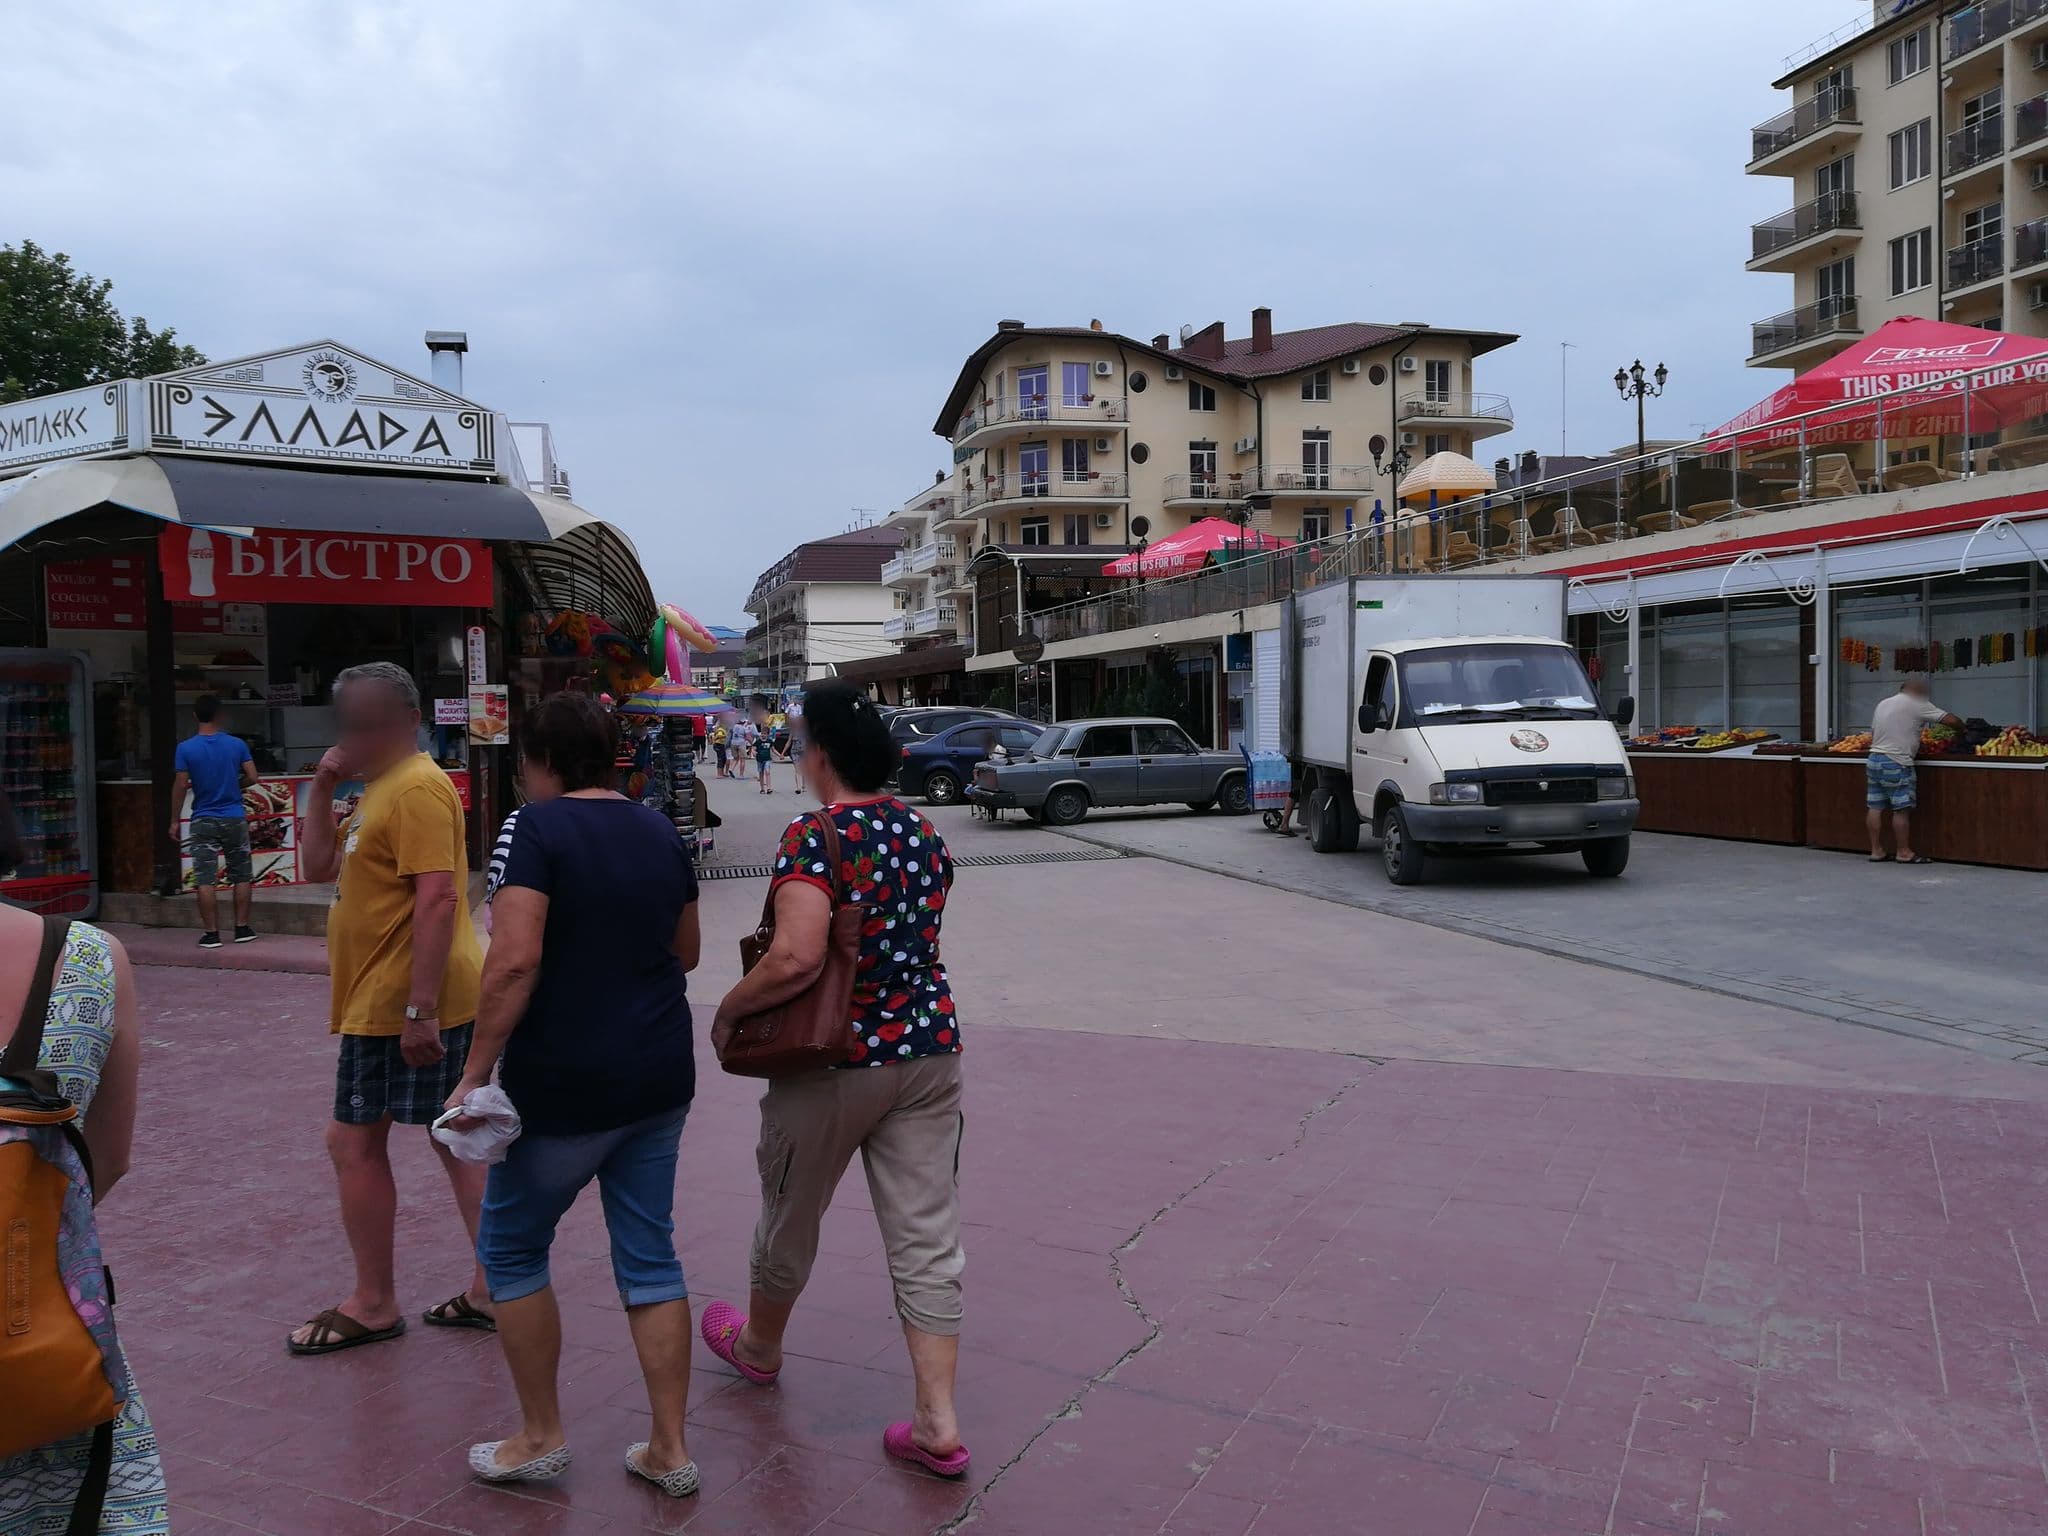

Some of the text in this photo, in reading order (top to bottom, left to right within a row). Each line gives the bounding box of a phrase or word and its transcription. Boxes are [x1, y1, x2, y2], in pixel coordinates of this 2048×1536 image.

[1882, 345, 1971, 360] Bud
[1840, 375, 1892, 398] THIS
[1898, 369, 1965, 393] BUD'S
[1971, 364, 2016, 389] FOR
[202, 395, 451, 456] ЭЛЛАДА
[227, 534, 472, 583] БИСТРО
[1115, 562, 1132, 574] THIS
[1154, 556, 1169, 569] FOR
[1170, 554, 1185, 566] YOU
